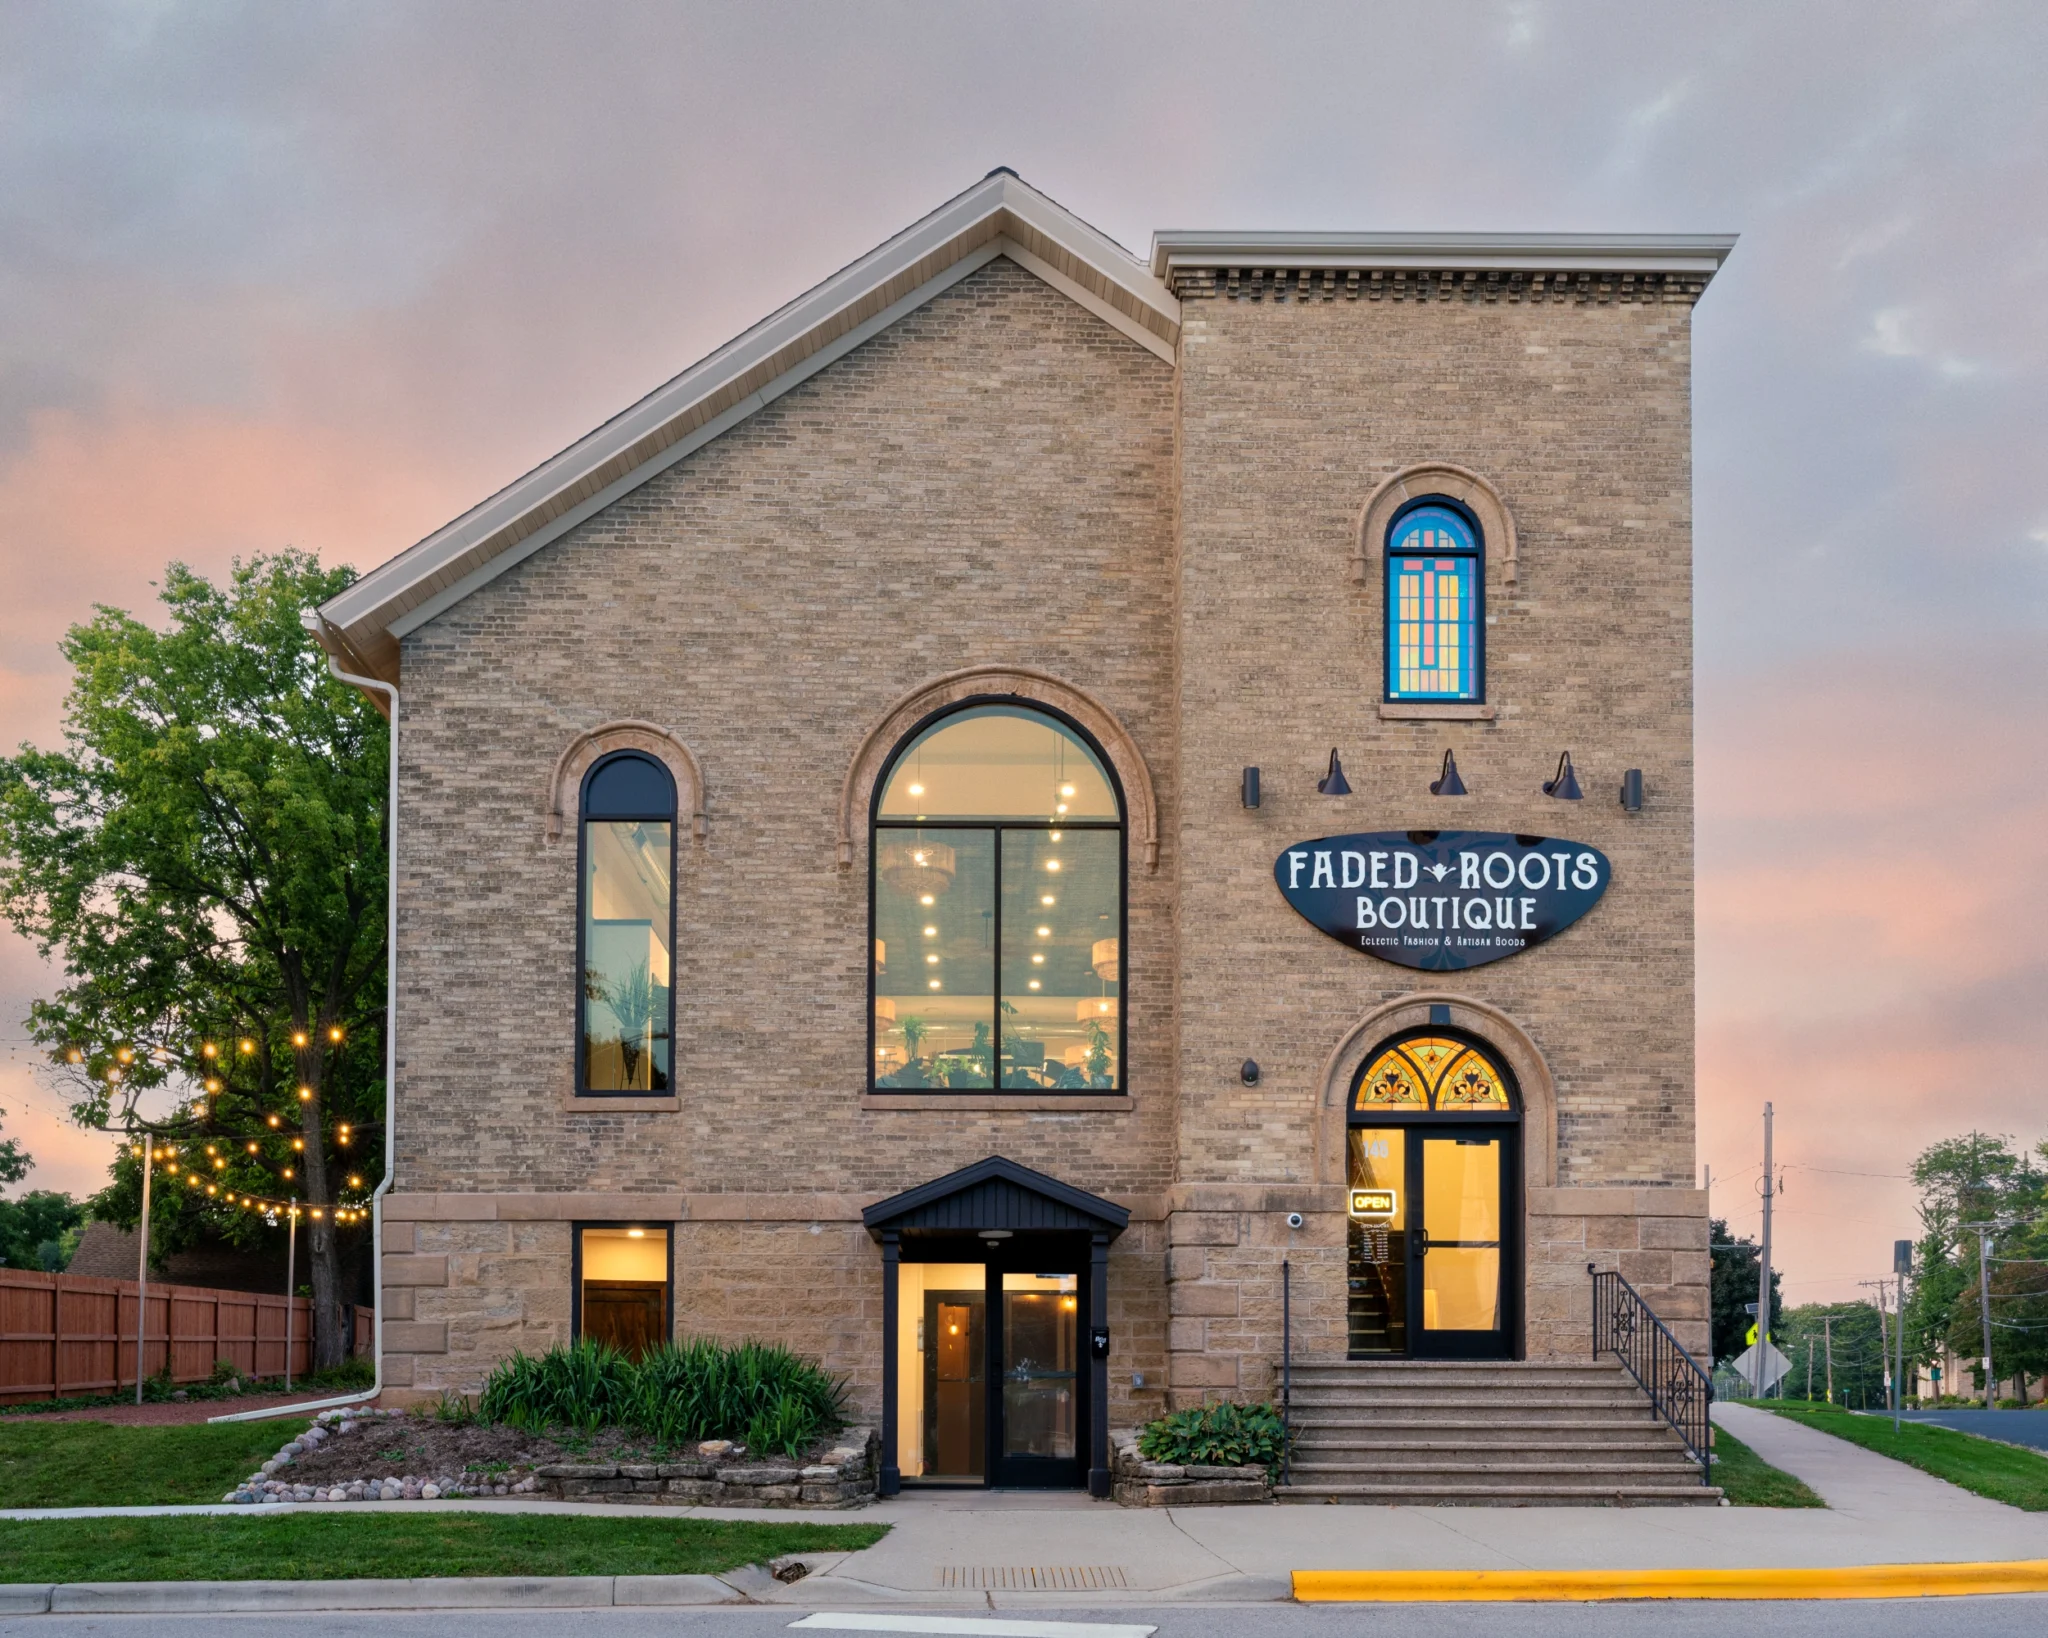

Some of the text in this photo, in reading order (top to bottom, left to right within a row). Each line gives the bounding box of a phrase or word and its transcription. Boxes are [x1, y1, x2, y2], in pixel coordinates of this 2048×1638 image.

[1288, 851, 1598, 891] FADED ROOTS
[1356, 896, 1537, 930] BOUTIQUE
[1444, 935, 1452, 946] &
[1363, 1140, 1389, 1158] 146
[1355, 1196, 1390, 1209] OPEN
